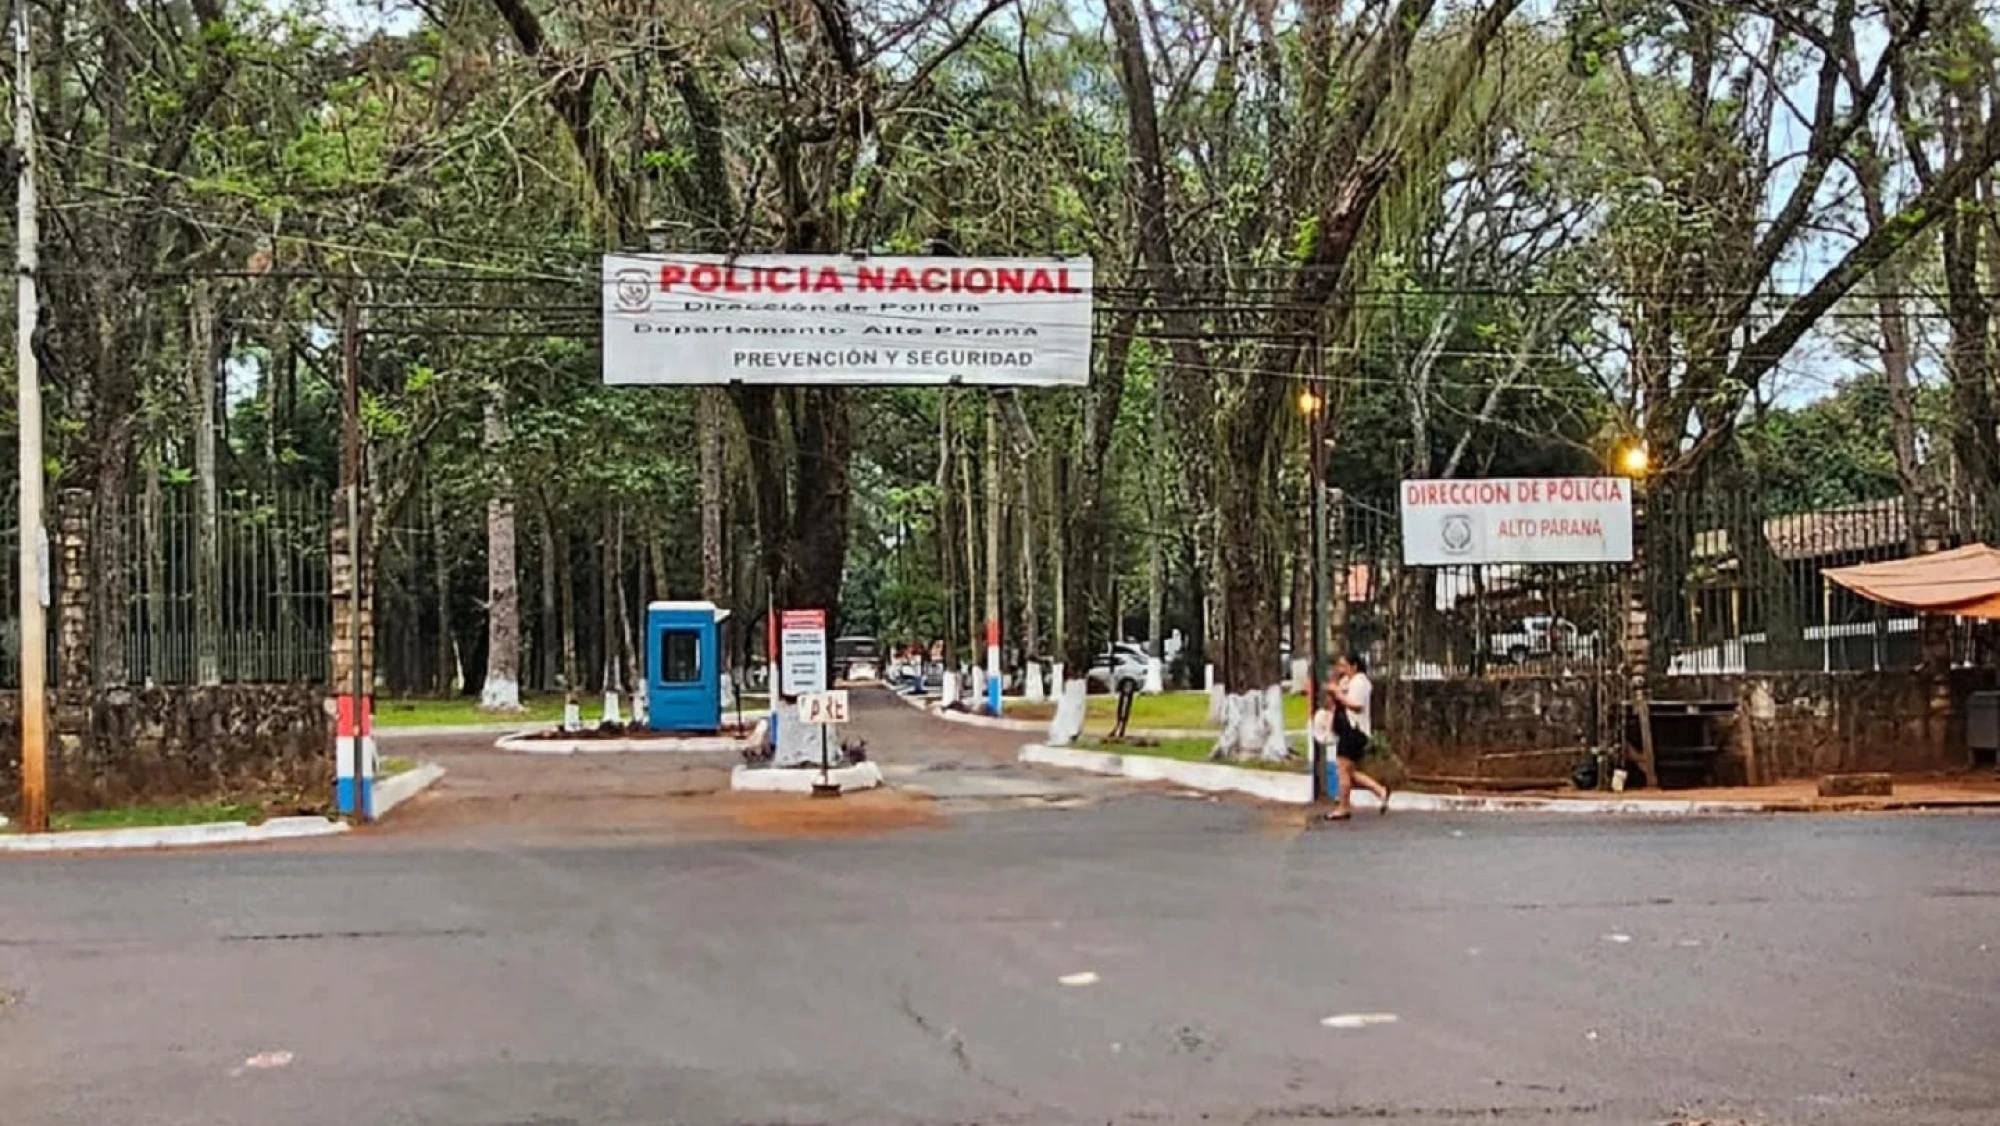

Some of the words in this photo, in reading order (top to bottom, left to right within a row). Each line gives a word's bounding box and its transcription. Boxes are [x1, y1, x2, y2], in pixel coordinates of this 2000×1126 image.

[660, 264, 844, 293] POLICIA
[857, 267, 1083, 294] NACIONAL
[834, 303, 868, 312] de
[862, 325, 922, 335] Alto
[886, 351, 899, 365] Y
[907, 351, 1033, 367] SEGURIDAD
[1517, 482, 1541, 502] DE
[1498, 520, 1536, 537] ALTO
